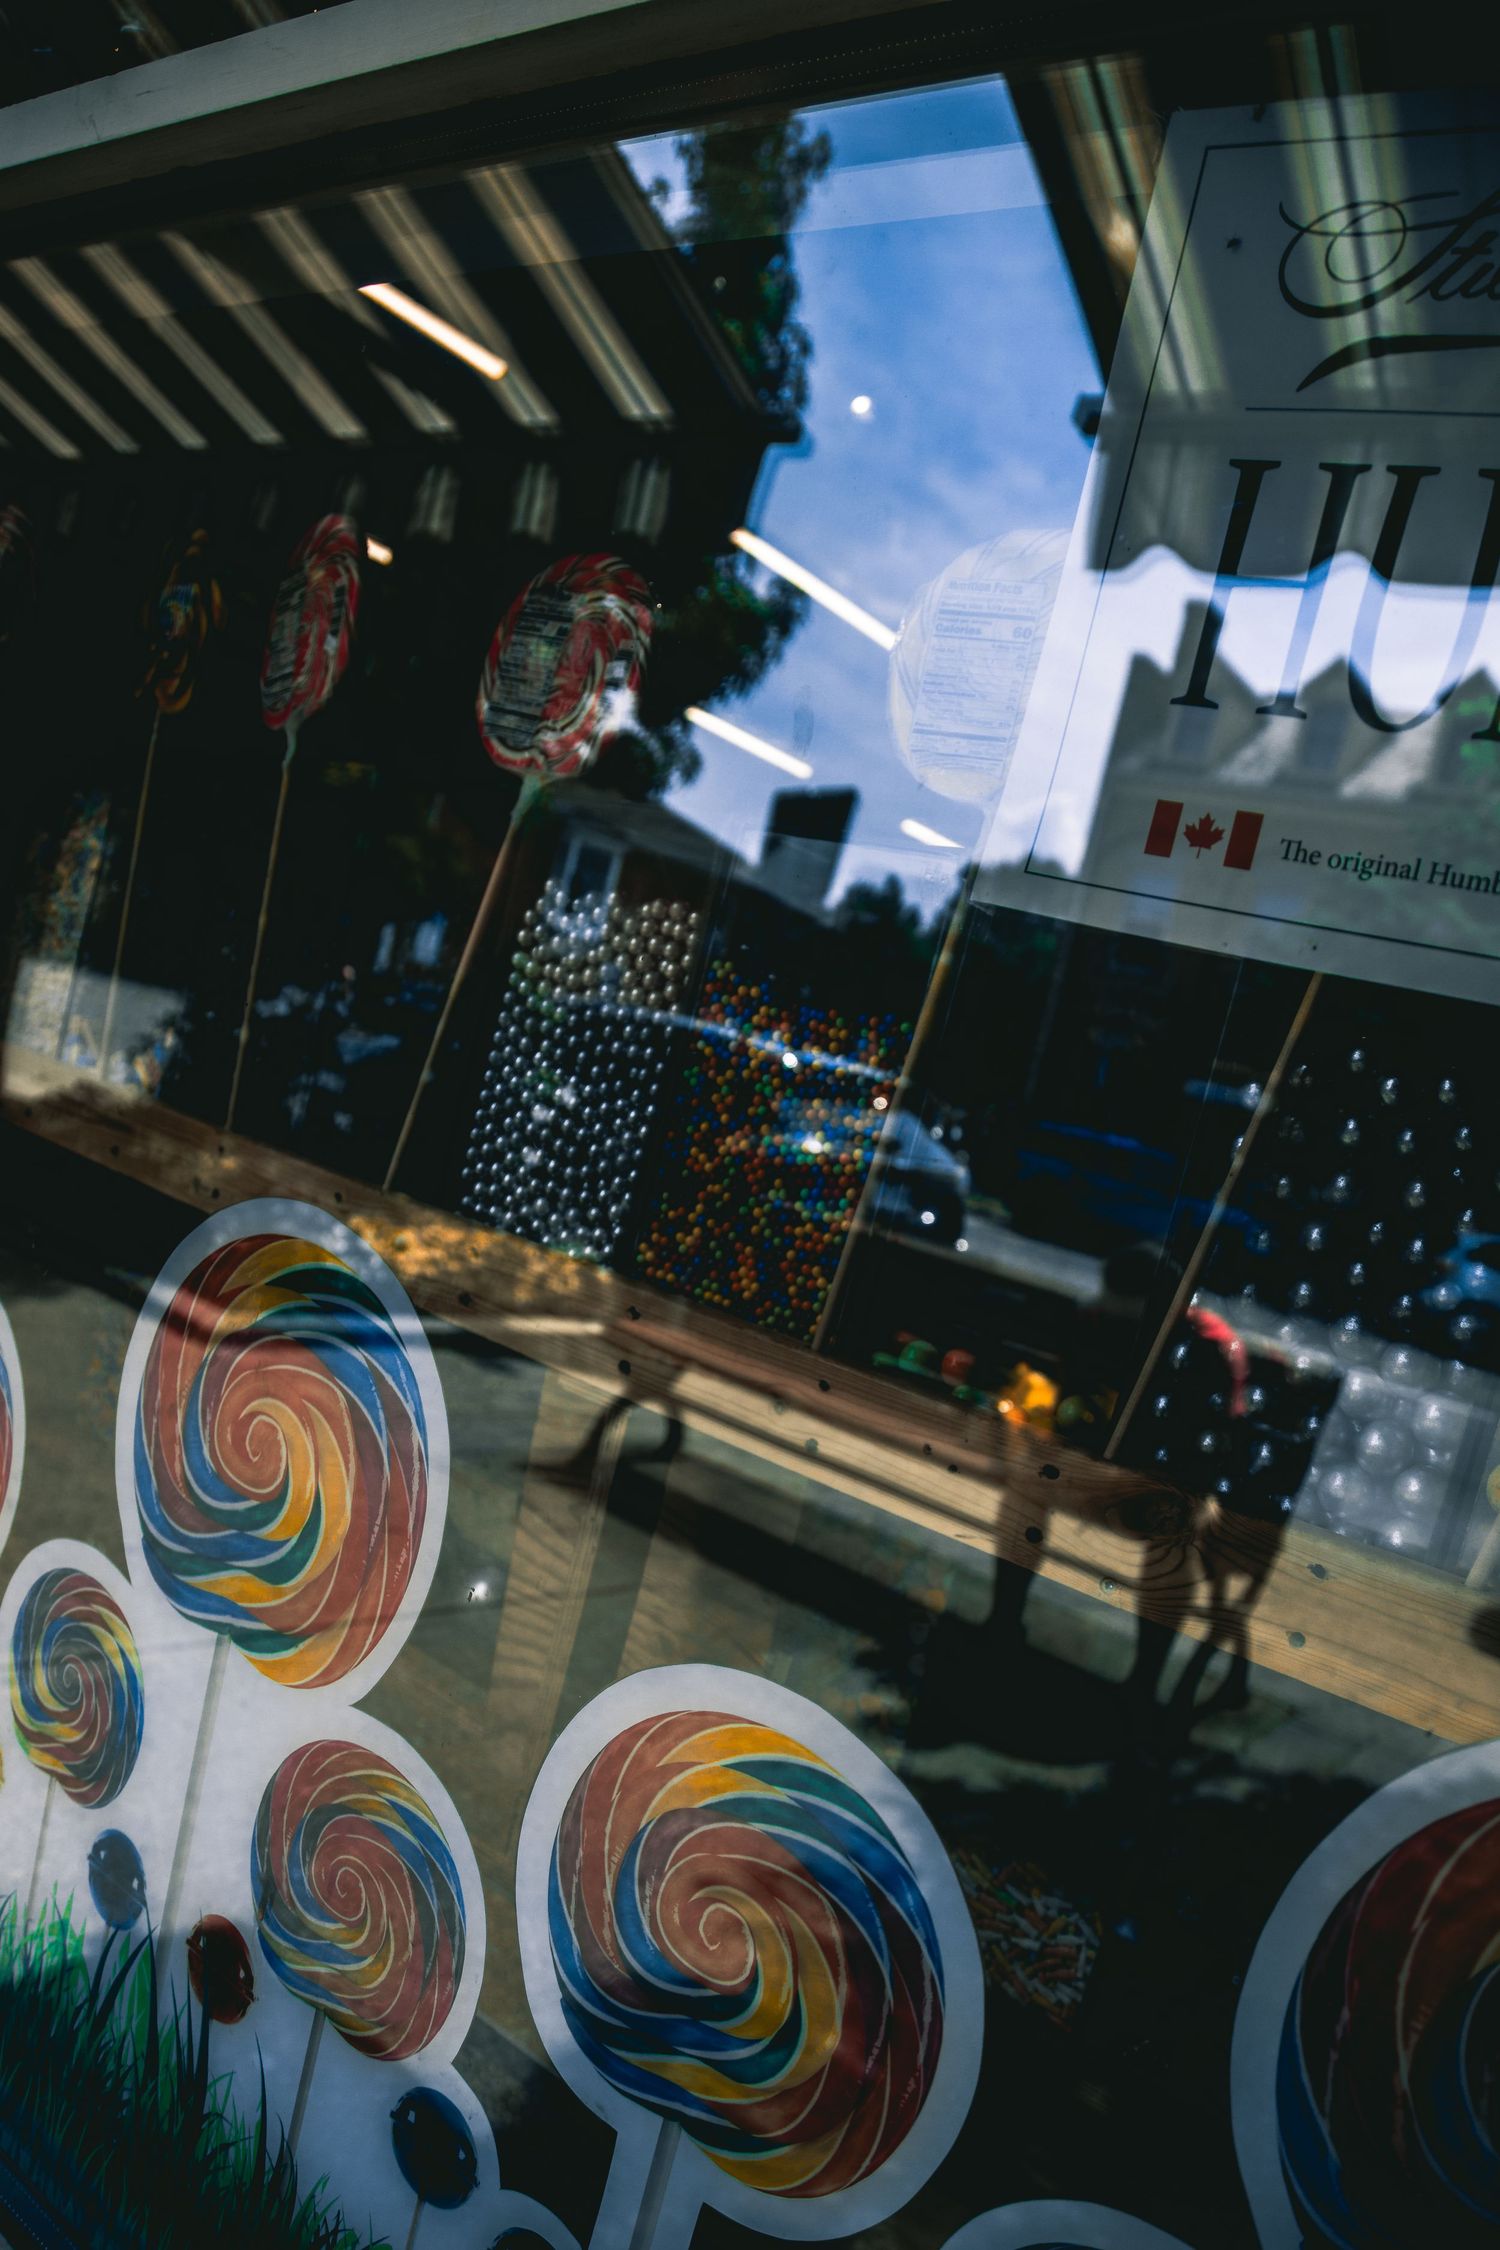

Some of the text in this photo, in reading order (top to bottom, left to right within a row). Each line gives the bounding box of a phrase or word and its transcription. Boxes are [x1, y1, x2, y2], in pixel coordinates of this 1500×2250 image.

[1169, 457, 1500, 741] HU
[935, 623, 1033, 640] Calories 60
[1280, 838, 1322, 866] The
[1327, 851, 1423, 882] original
